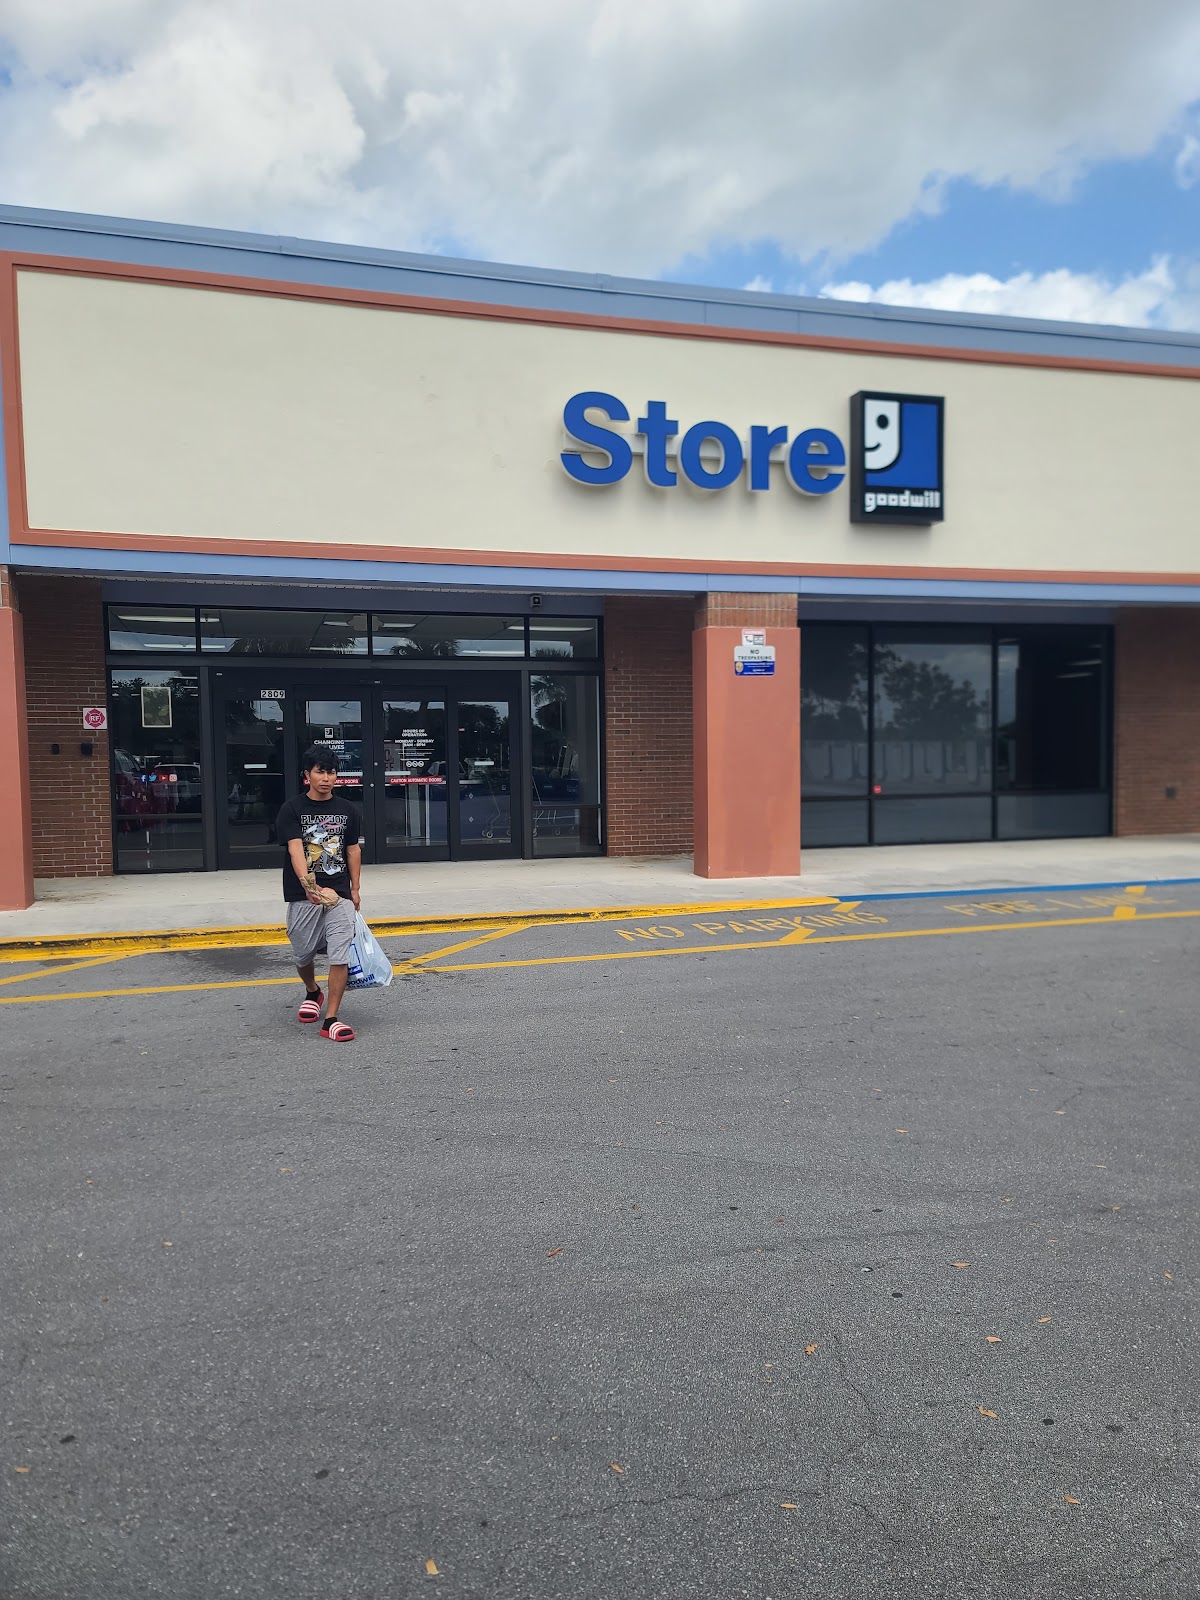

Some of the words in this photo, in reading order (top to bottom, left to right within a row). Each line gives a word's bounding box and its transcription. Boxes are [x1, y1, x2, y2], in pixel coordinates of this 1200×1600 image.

[561, 391, 846, 496] Store
[864, 490, 940, 512] goodwill
[261, 690, 285, 699] 2809
[614, 925, 685, 942] NO
[692, 911, 889, 936] PARKING
[346, 973, 376, 986] oodwill
